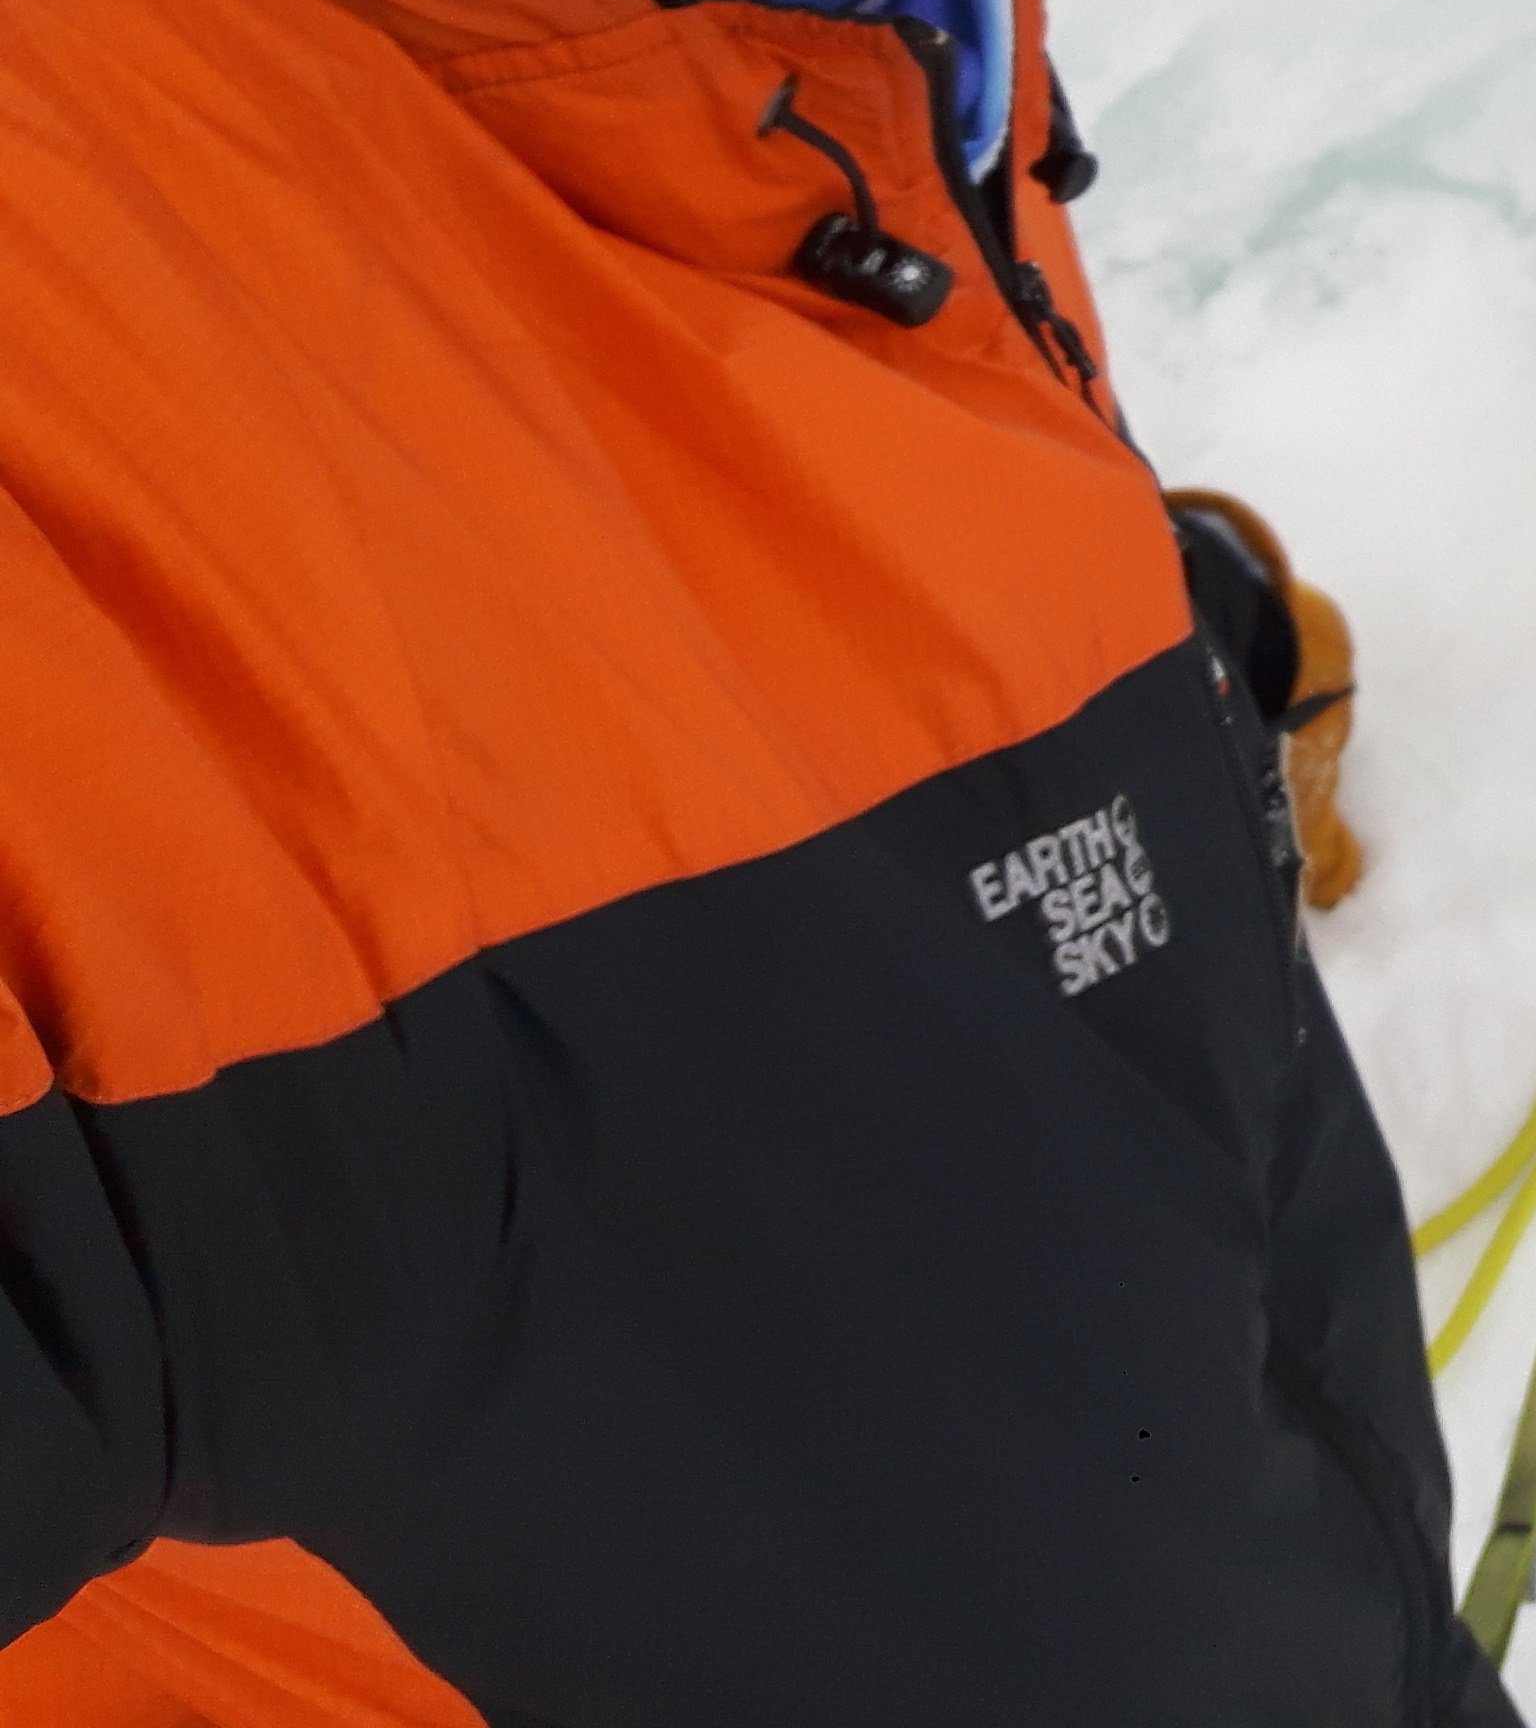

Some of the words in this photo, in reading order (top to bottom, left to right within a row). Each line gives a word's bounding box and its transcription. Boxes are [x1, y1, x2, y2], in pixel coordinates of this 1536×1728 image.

[969, 809, 1116, 922] EARTH
[1041, 863, 1133, 944] SEA
[1054, 911, 1137, 997] SKY
